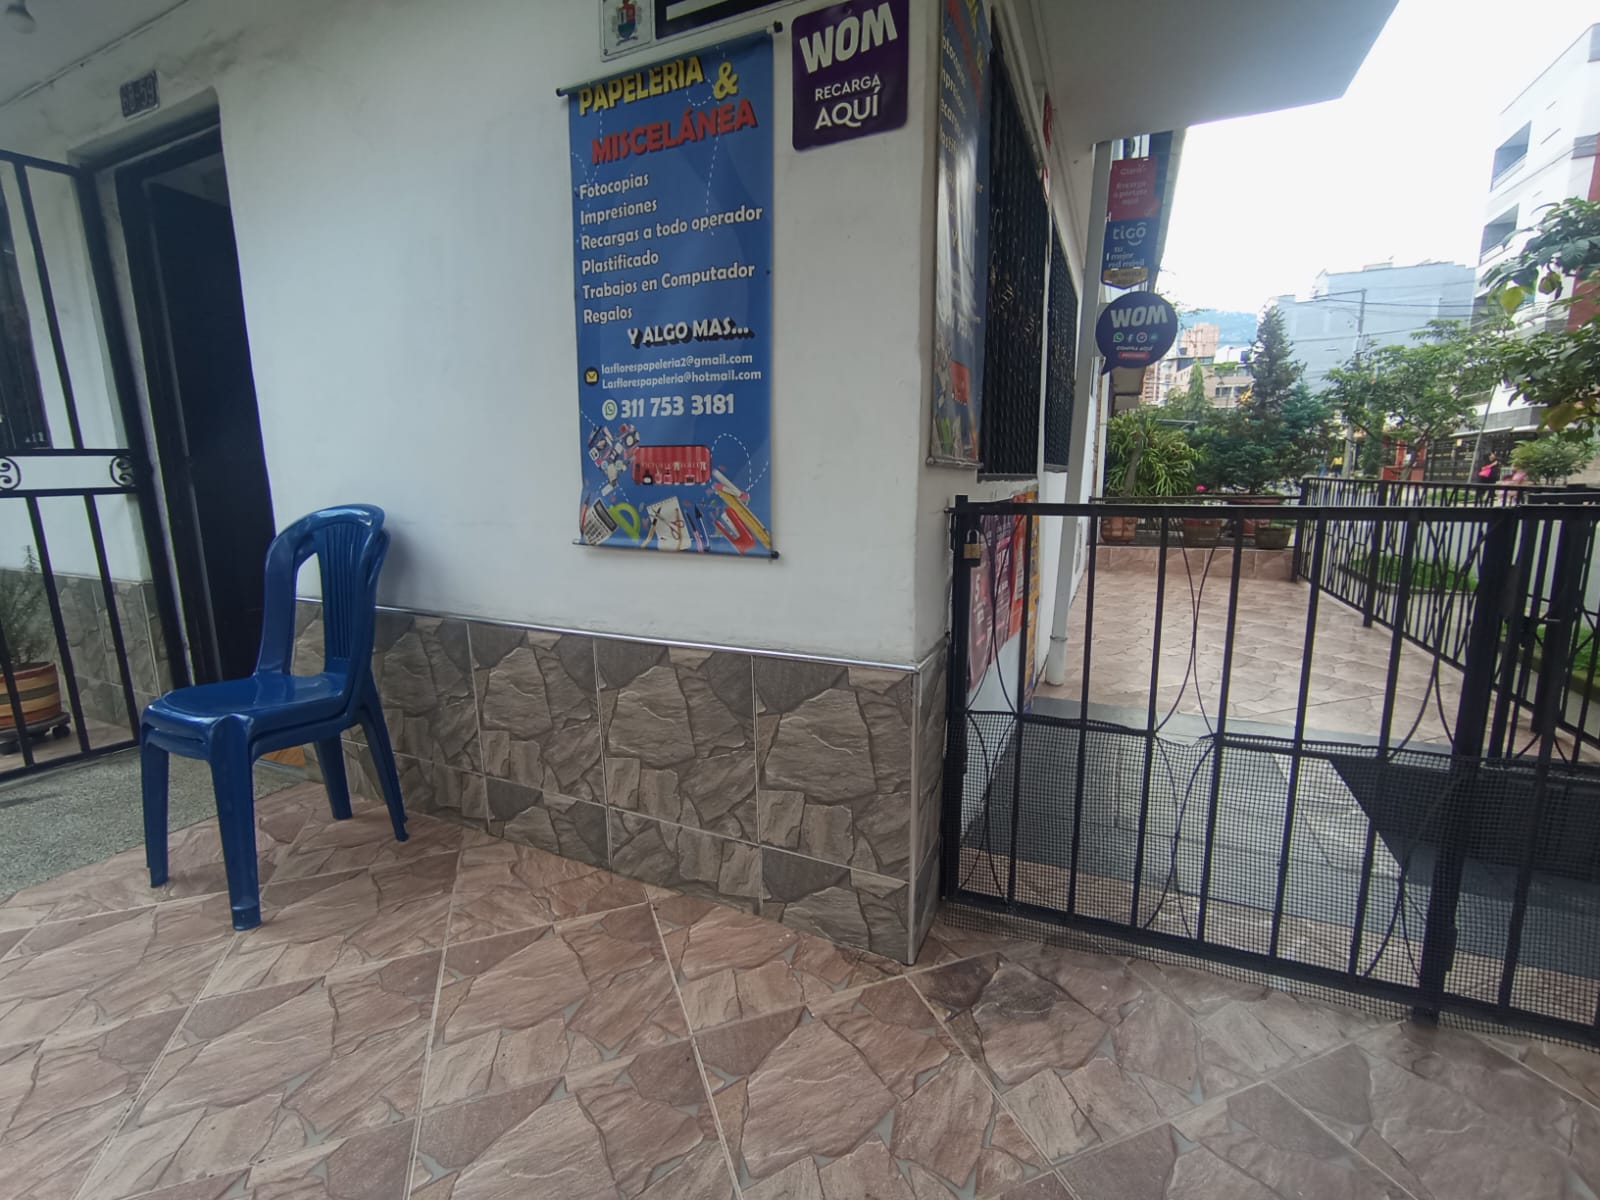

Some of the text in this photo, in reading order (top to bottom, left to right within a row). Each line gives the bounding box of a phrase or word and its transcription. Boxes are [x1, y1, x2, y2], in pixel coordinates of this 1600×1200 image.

[799, 2, 898, 74] WOM
[713, 61, 739, 100] &
[815, 73, 881, 102] RECARGA
[815, 86, 881, 130] AQUÍ
[591, 98, 758, 165] MISCELÁNEA
[579, 173, 649, 200] Fotocopias
[580, 199, 658, 225] Impresiones
[581, 204, 763, 250] Recargas a todo operador
[581, 249, 659, 275] Plastificado
[582, 262, 755, 299] Trabajos en Computador
[583, 305, 633, 324] Regalos
[1110, 305, 1168, 328] WOM
[627, 316, 749, 345] Y ALGO MAS...
[601, 353, 753, 375] lasflorespapeleria2@gmail.com
[602, 369, 762, 389] Lasflorespapeleria@hotmail.com
[620, 393, 735, 418] 311 753 3181
